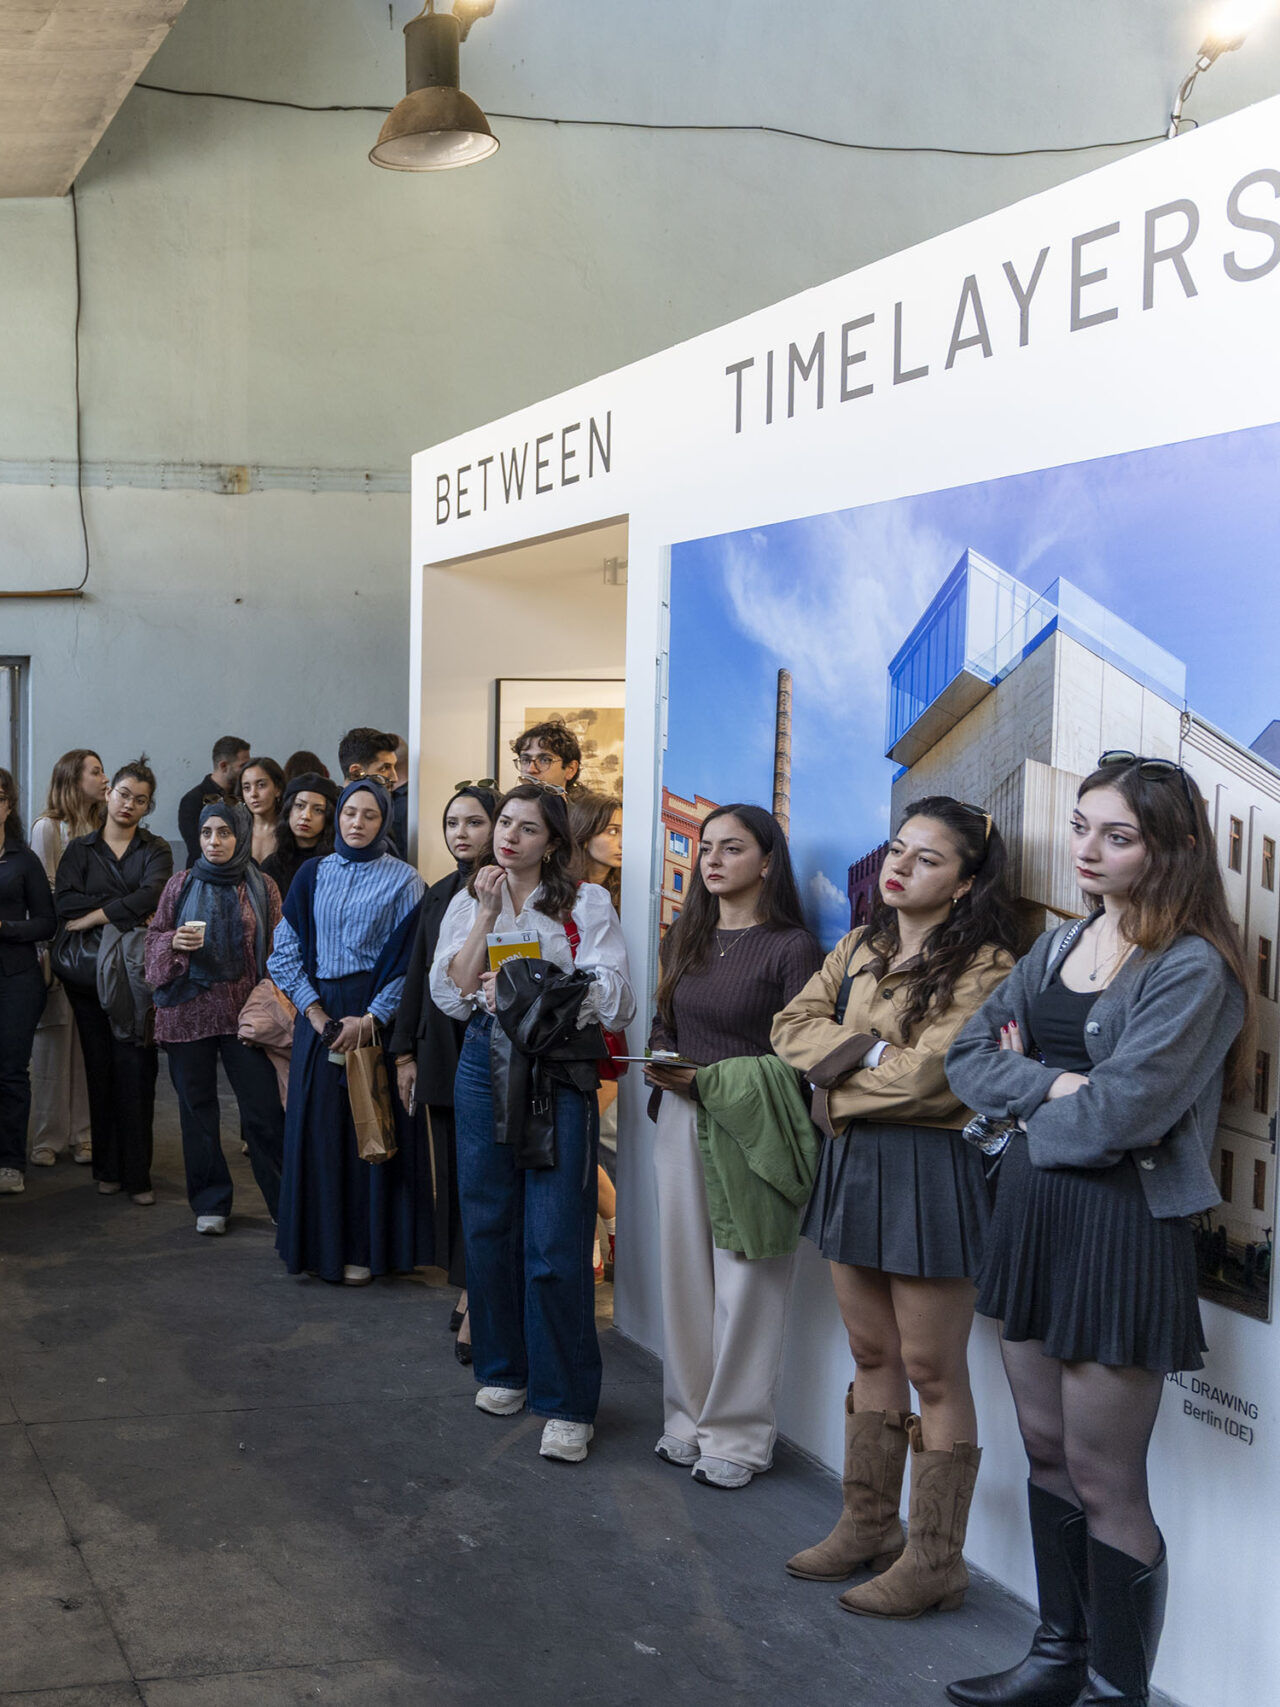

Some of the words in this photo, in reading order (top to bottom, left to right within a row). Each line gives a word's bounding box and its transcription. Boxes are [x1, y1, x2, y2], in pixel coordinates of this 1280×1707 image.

[436, 410, 612, 526] BETWEEN
[725, 168, 1280, 434] TIMELAYERS
[1183, 1398, 1222, 1430] Berlin
[1224, 1416, 1254, 1446] (DE)
[1191, 1377, 1259, 1420] DRAWING
